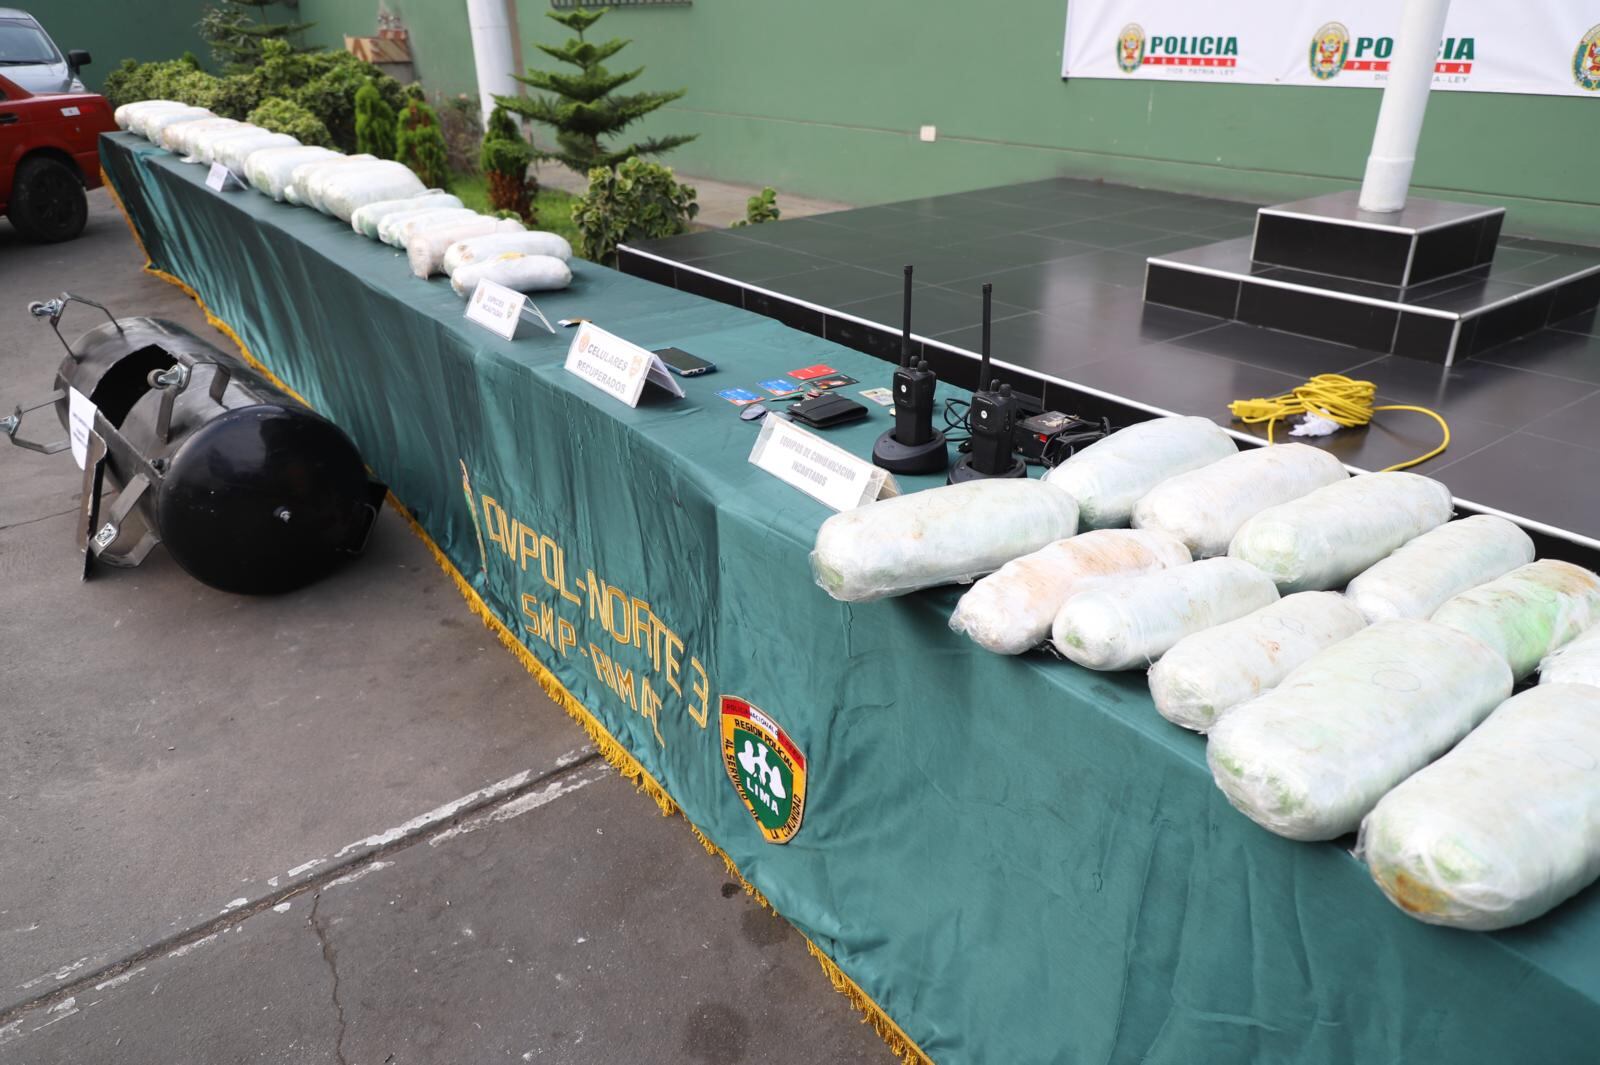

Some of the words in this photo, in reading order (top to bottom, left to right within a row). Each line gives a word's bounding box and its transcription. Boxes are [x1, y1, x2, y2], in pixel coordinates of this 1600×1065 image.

[1149, 58, 1233, 67] PERUANA
[1150, 36, 1239, 55] POLICIA
[1355, 37, 1475, 60] POIA
[587, 344, 628, 372] CELULARES
[576, 360, 627, 394] RECUPERADOS
[688, 656, 709, 729] 3
[725, 738, 733, 750] AL
[734, 719, 763, 739] REGION
[764, 735, 794, 773] POLICIAL
[726, 753, 748, 801] SERVICIO
[746, 777, 779, 816] LIMA
[781, 794, 801, 837] COMUNIDAD
